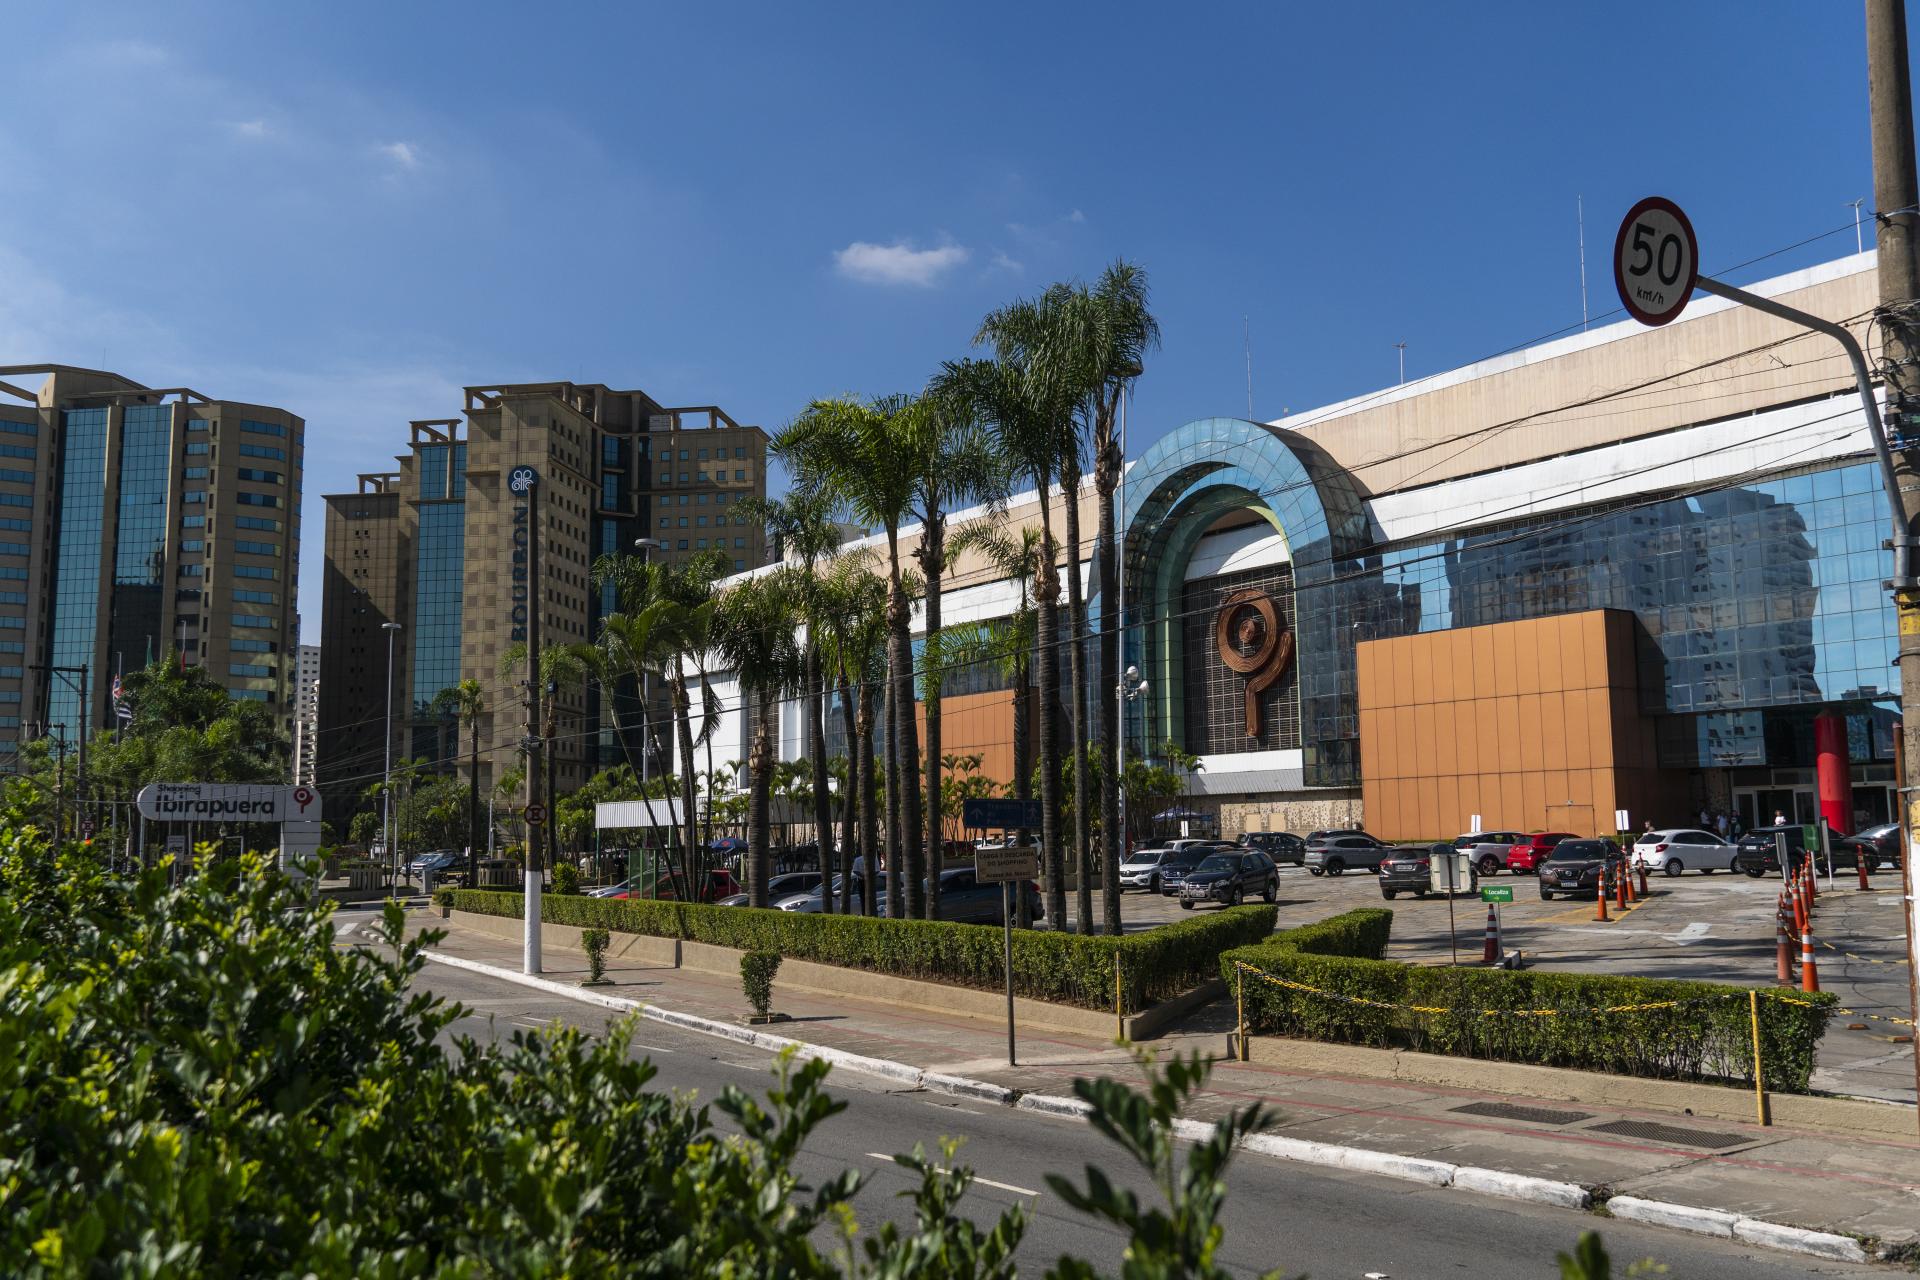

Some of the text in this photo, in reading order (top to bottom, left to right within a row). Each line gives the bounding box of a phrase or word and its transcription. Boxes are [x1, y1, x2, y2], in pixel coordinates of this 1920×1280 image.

[1629, 222, 1683, 286] 50
[1636, 287, 1664, 305] km/h
[511, 506, 529, 642] BOURBON
[157, 784, 201, 794] Shopping
[155, 794, 275, 818] Ibirapuera
